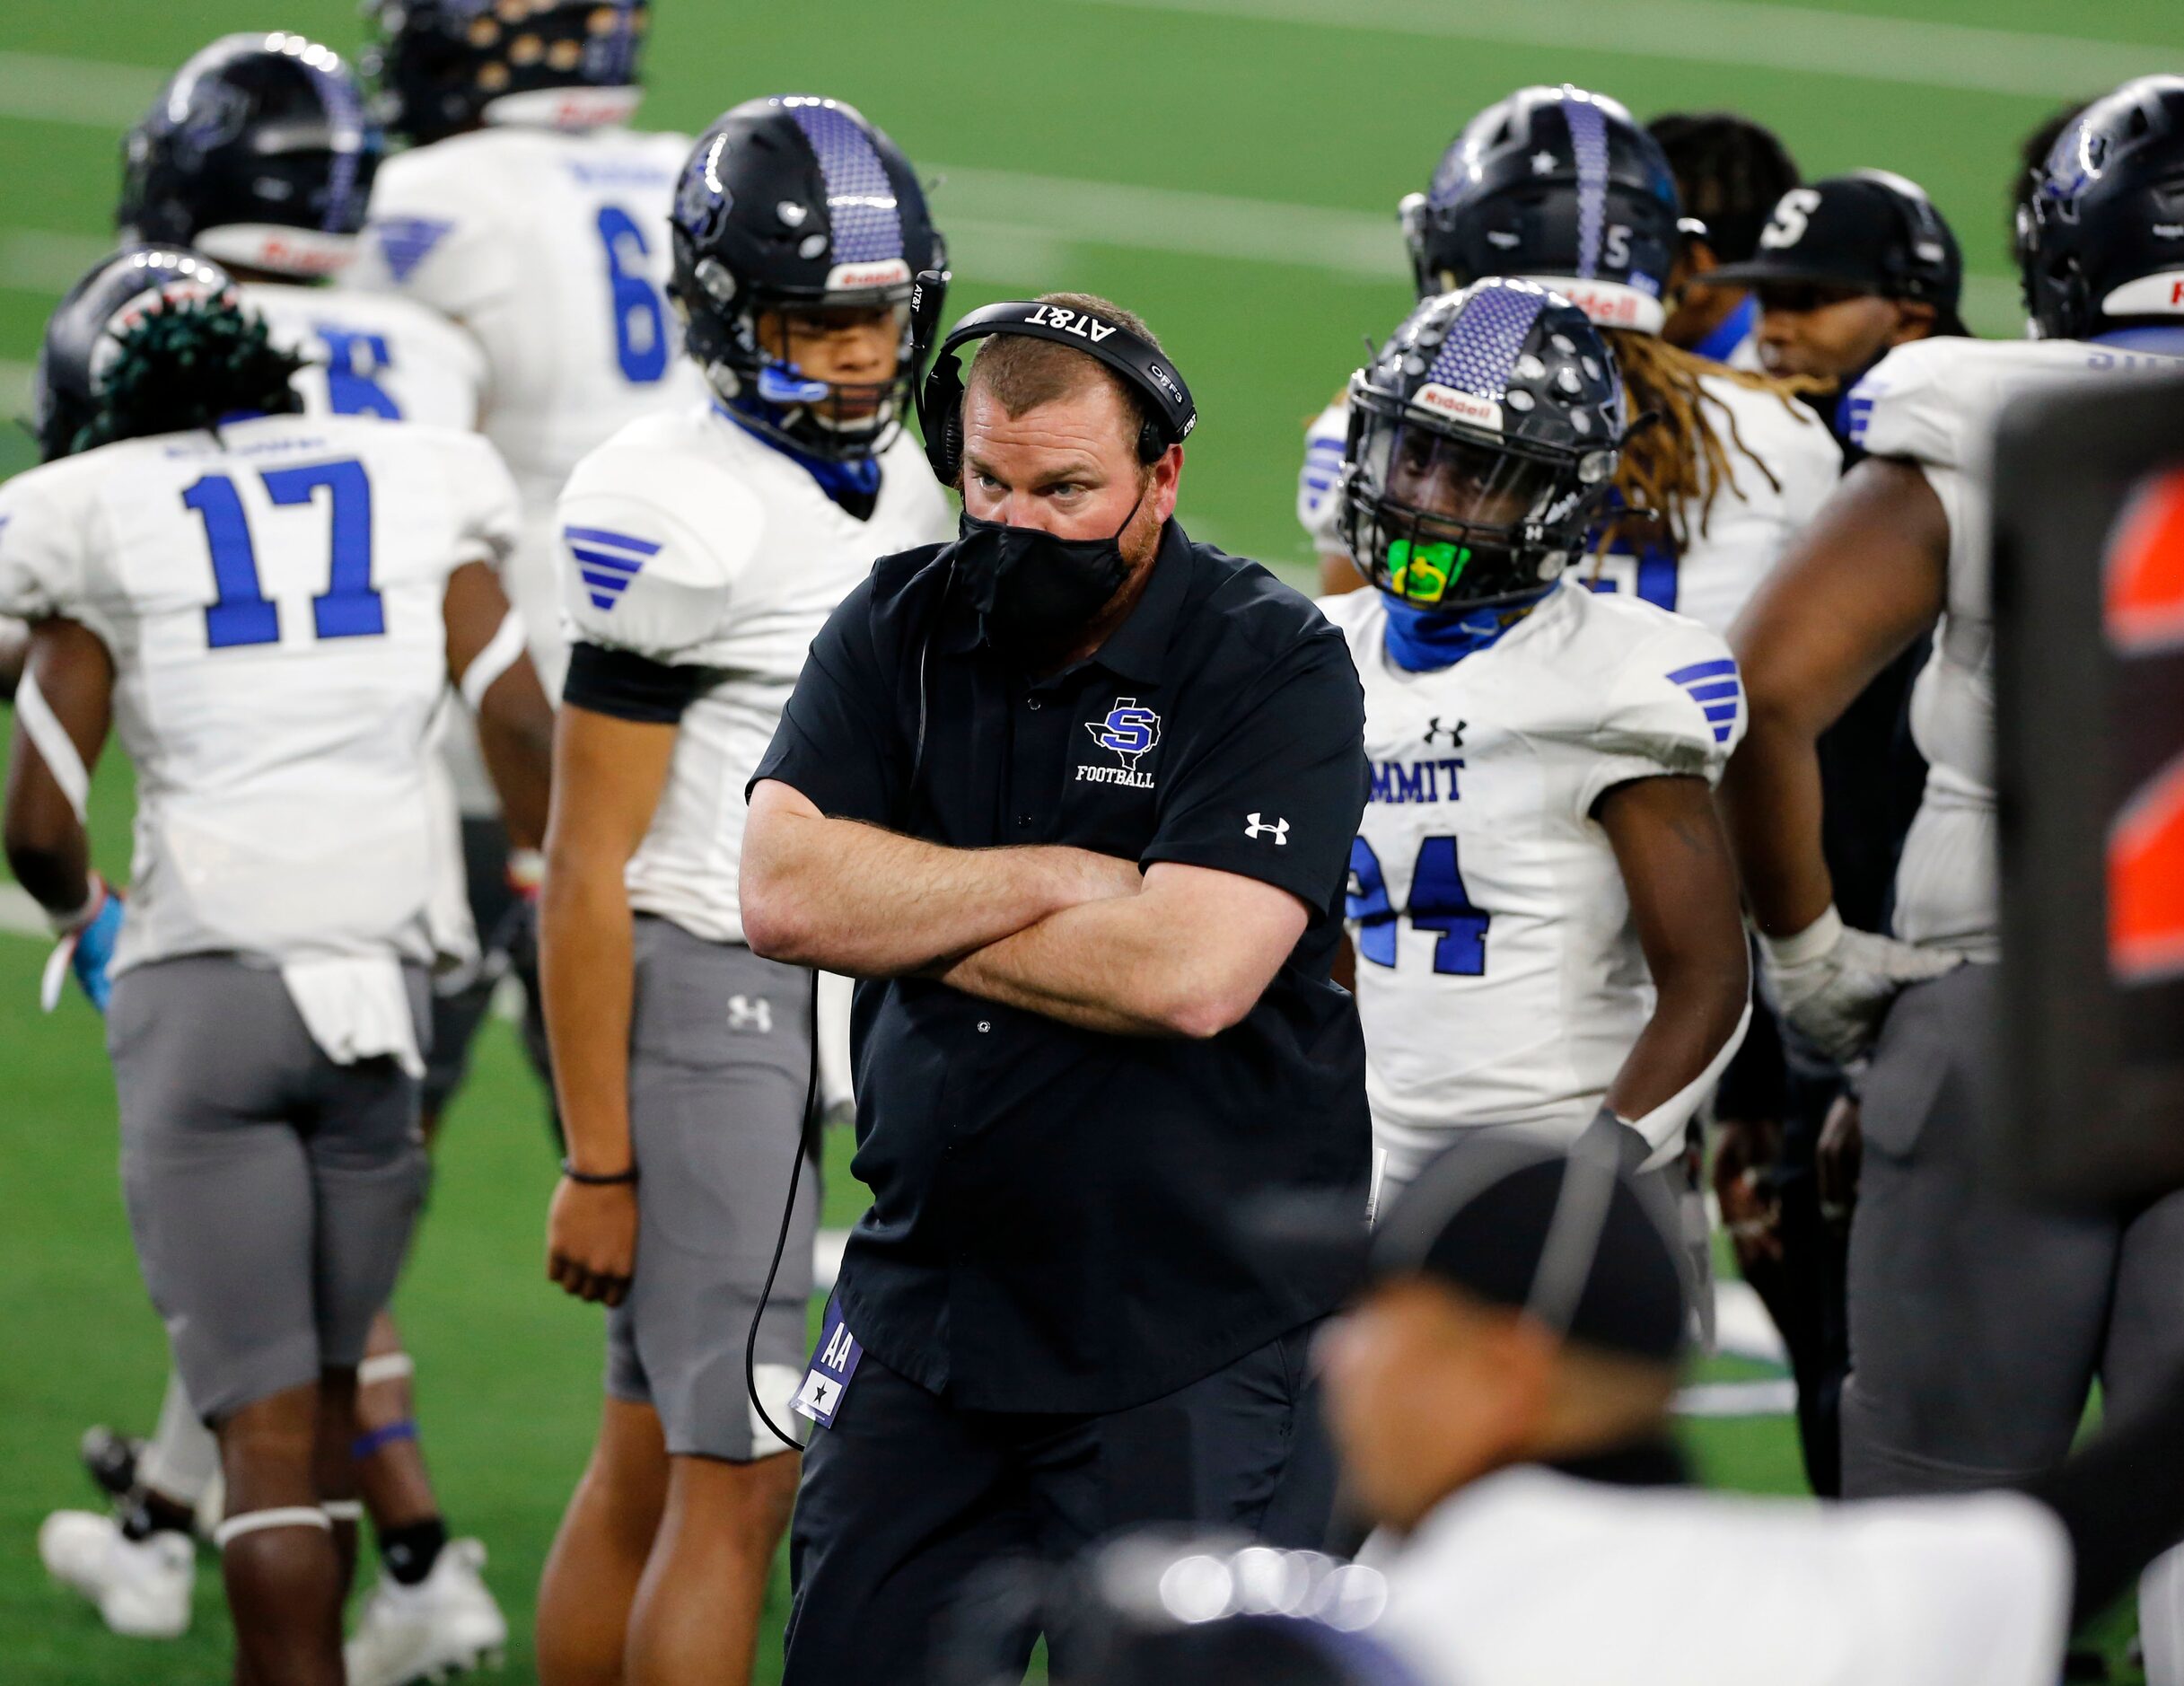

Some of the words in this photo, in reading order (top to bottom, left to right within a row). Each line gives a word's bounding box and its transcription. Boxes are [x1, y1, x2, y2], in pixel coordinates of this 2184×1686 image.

[1760, 188, 1823, 249] S
[597, 206, 667, 382] 6
[910, 283, 923, 312] AT&T
[1024, 305, 1118, 343] AT&T
[181, 459, 387, 648] 17
[1101, 707, 1156, 754] S
[1074, 765, 1155, 789] FOOTBALL
[820, 1321, 855, 1374] AA
